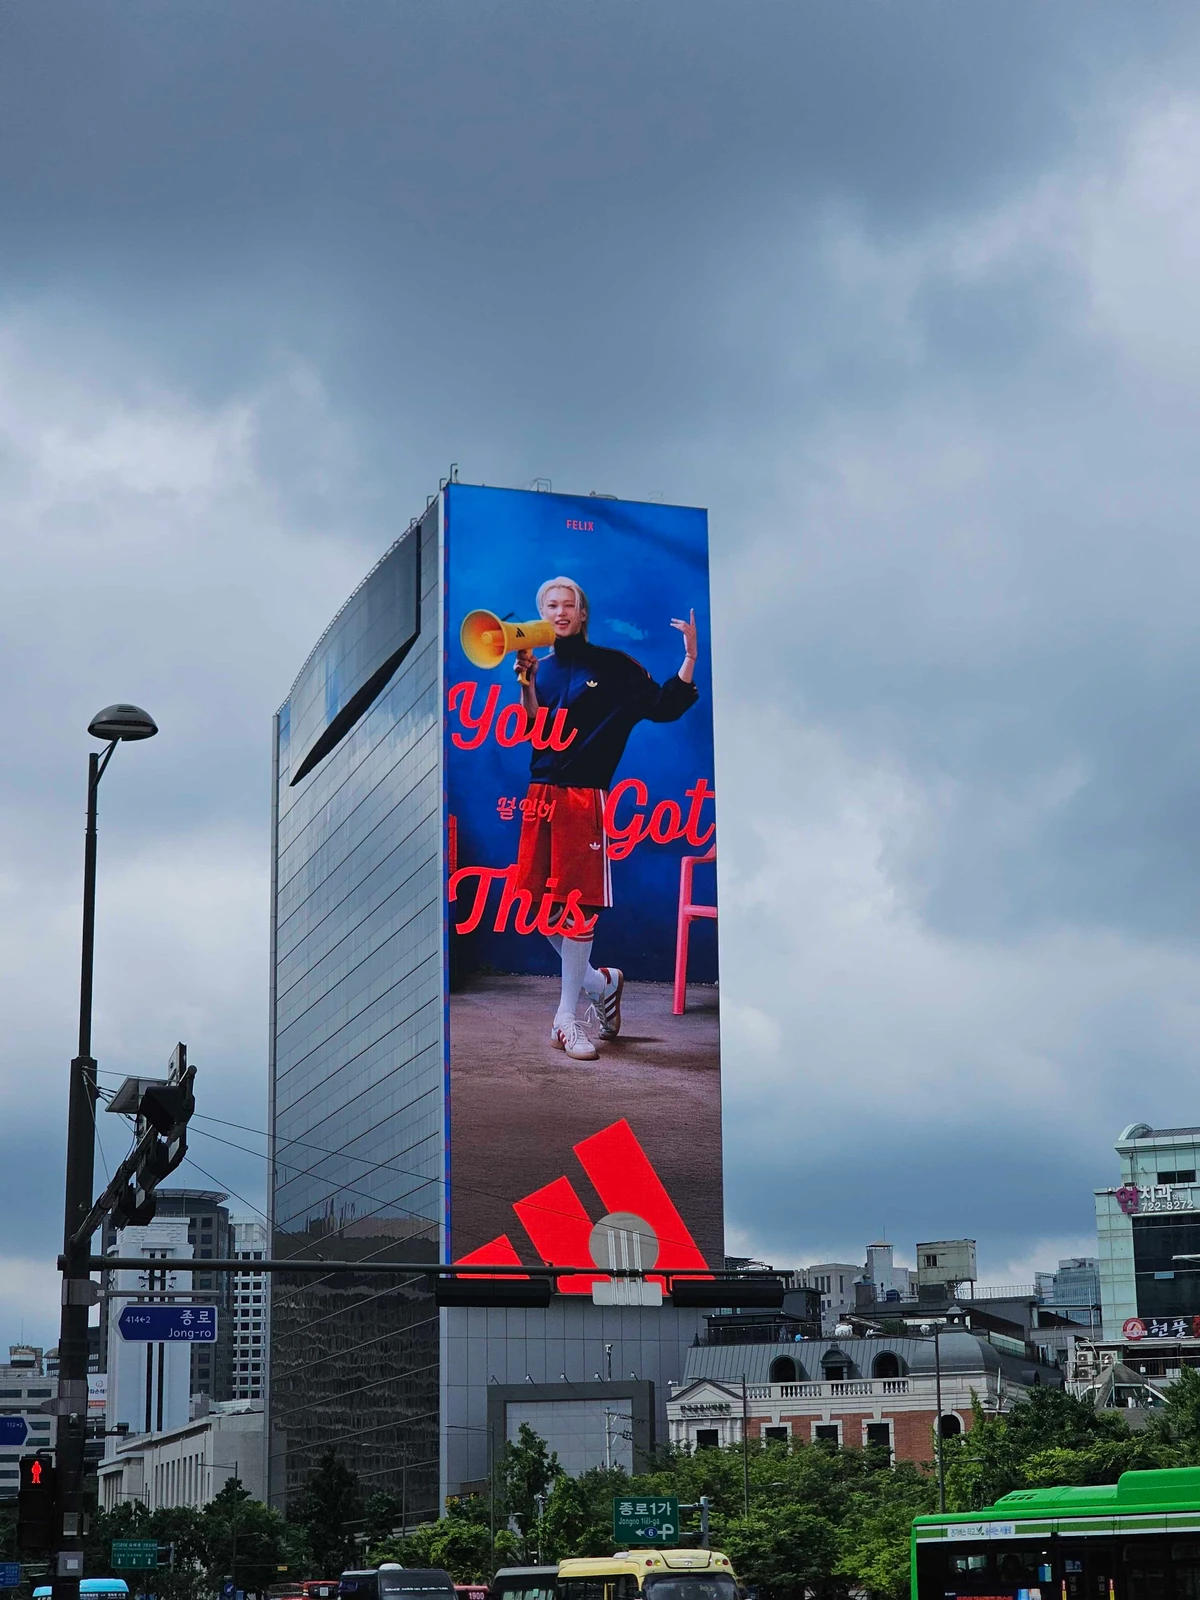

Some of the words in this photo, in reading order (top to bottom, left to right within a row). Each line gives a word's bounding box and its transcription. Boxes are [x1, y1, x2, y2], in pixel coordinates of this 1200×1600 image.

[566, 519, 594, 532] FELIX
[449, 681, 578, 752] You
[603, 778, 716, 861] Got
[449, 863, 599, 937] This
[1141, 1200, 1194, 1212] 722-8272
[125, 1315, 139, 1324] 414
[180, 1309, 212, 1326] 종로
[168, 1328, 212, 1340] Jong-ro
[1149, 1318, 1189, 1340] 현풍
[618, 1501, 672, 1516] 종로1가
[618, 1517, 640, 1527] Jongno
[648, 1528, 654, 1537] 6
[468, 1592, 485, 1600] 1900
